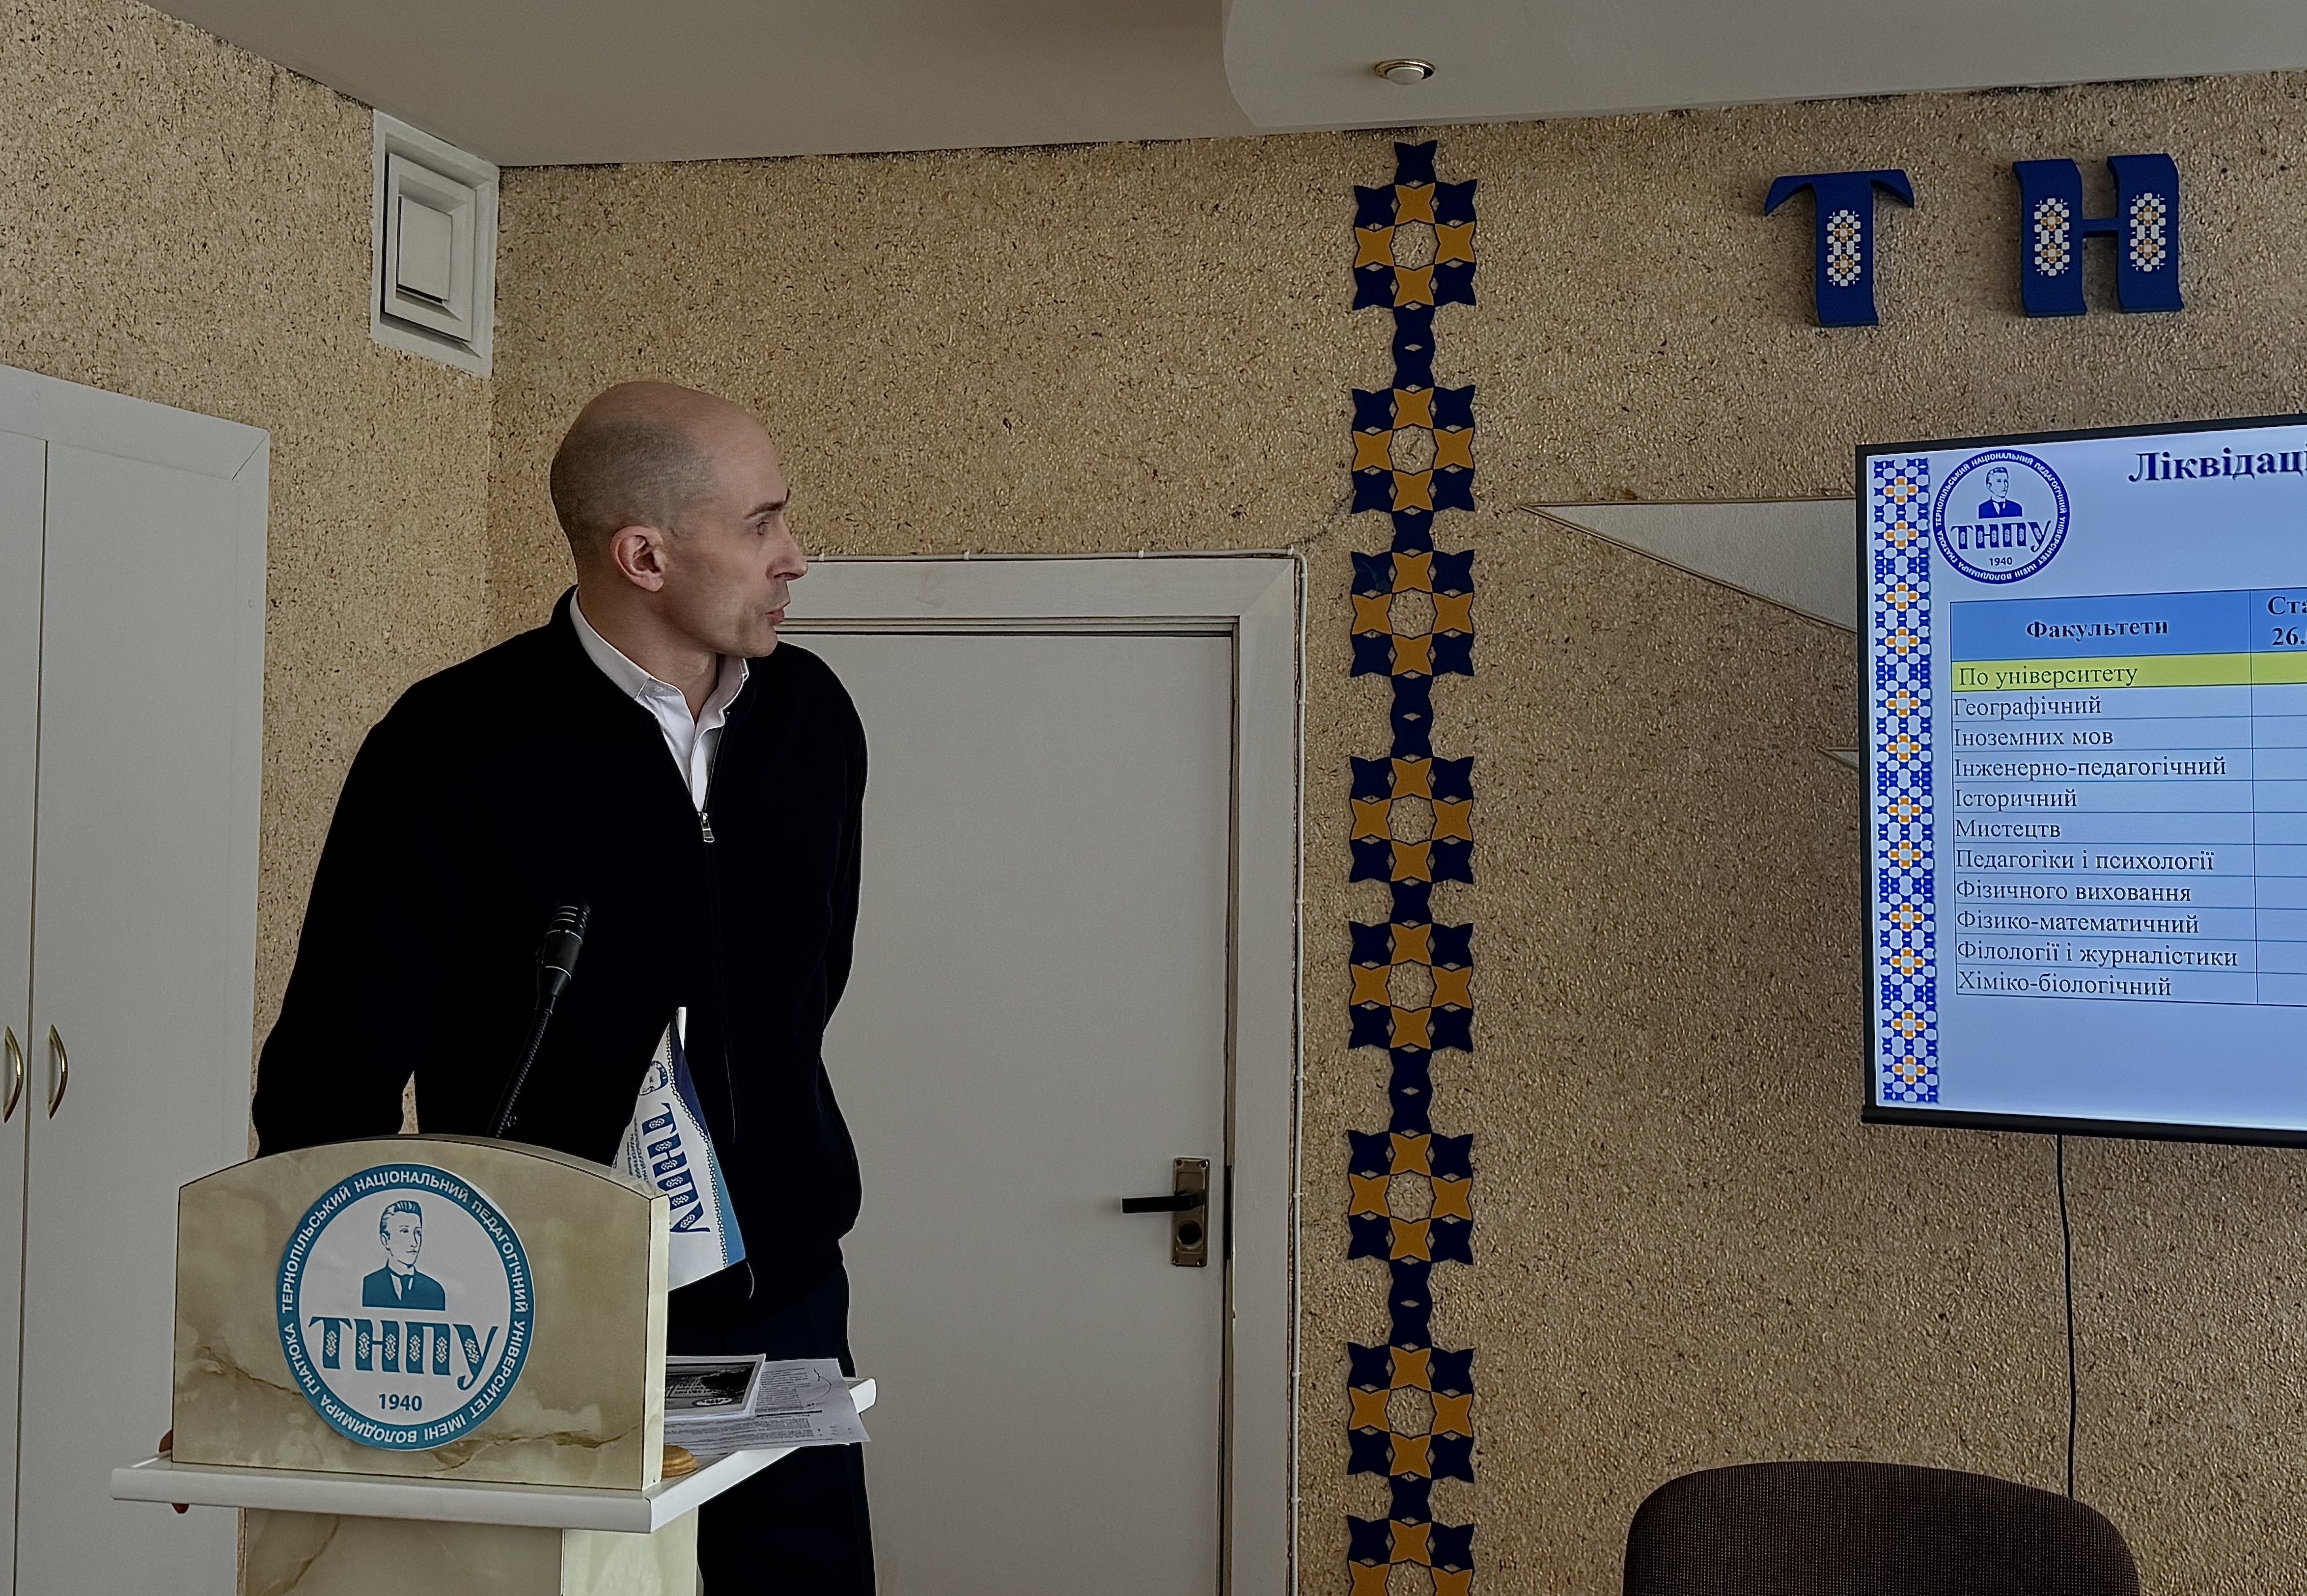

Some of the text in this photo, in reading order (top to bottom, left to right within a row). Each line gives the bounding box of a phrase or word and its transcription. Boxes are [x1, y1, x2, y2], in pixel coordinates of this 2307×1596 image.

[2128, 442, 2307, 482] Ліквідац
[1950, 521, 2051, 552] ТНПУ
[1989, 557, 2013, 566] 1940
[2027, 620, 2168, 641] Факультети
[1959, 665, 2138, 689] По університету
[1953, 695, 2102, 720] Географічний
[1954, 729, 2113, 746] Іноземних мов
[1954, 756, 2226, 781] Інженерно-педагогічний
[1955, 788, 2077, 812] Історичний
[1955, 819, 2061, 839] Мистецтв
[1956, 849, 2215, 871] Педагогіки і психології
[1956, 880, 2192, 902] Фізичного виховання
[1957, 909, 2199, 934] Фізико-математичний
[1958, 940, 2238, 968] Філології і журналістики
[1958, 970, 2171, 996] Хіміко-біологічний
[641, 1102, 711, 1233] ТНПУ
[282, 1171, 528, 1443] ТЕРНОПІЛЬСЬКИЙ НАЦІОНАЛЬНИЙ ПЕДАГОГІЧНИЙ УНІВЕРСИТЕТ ІМЕНІ ВОЛОДИМИРА ГНАТЮКА
[308, 1317, 499, 1391] ТНПУ
[379, 1394, 423, 1412] 1940
